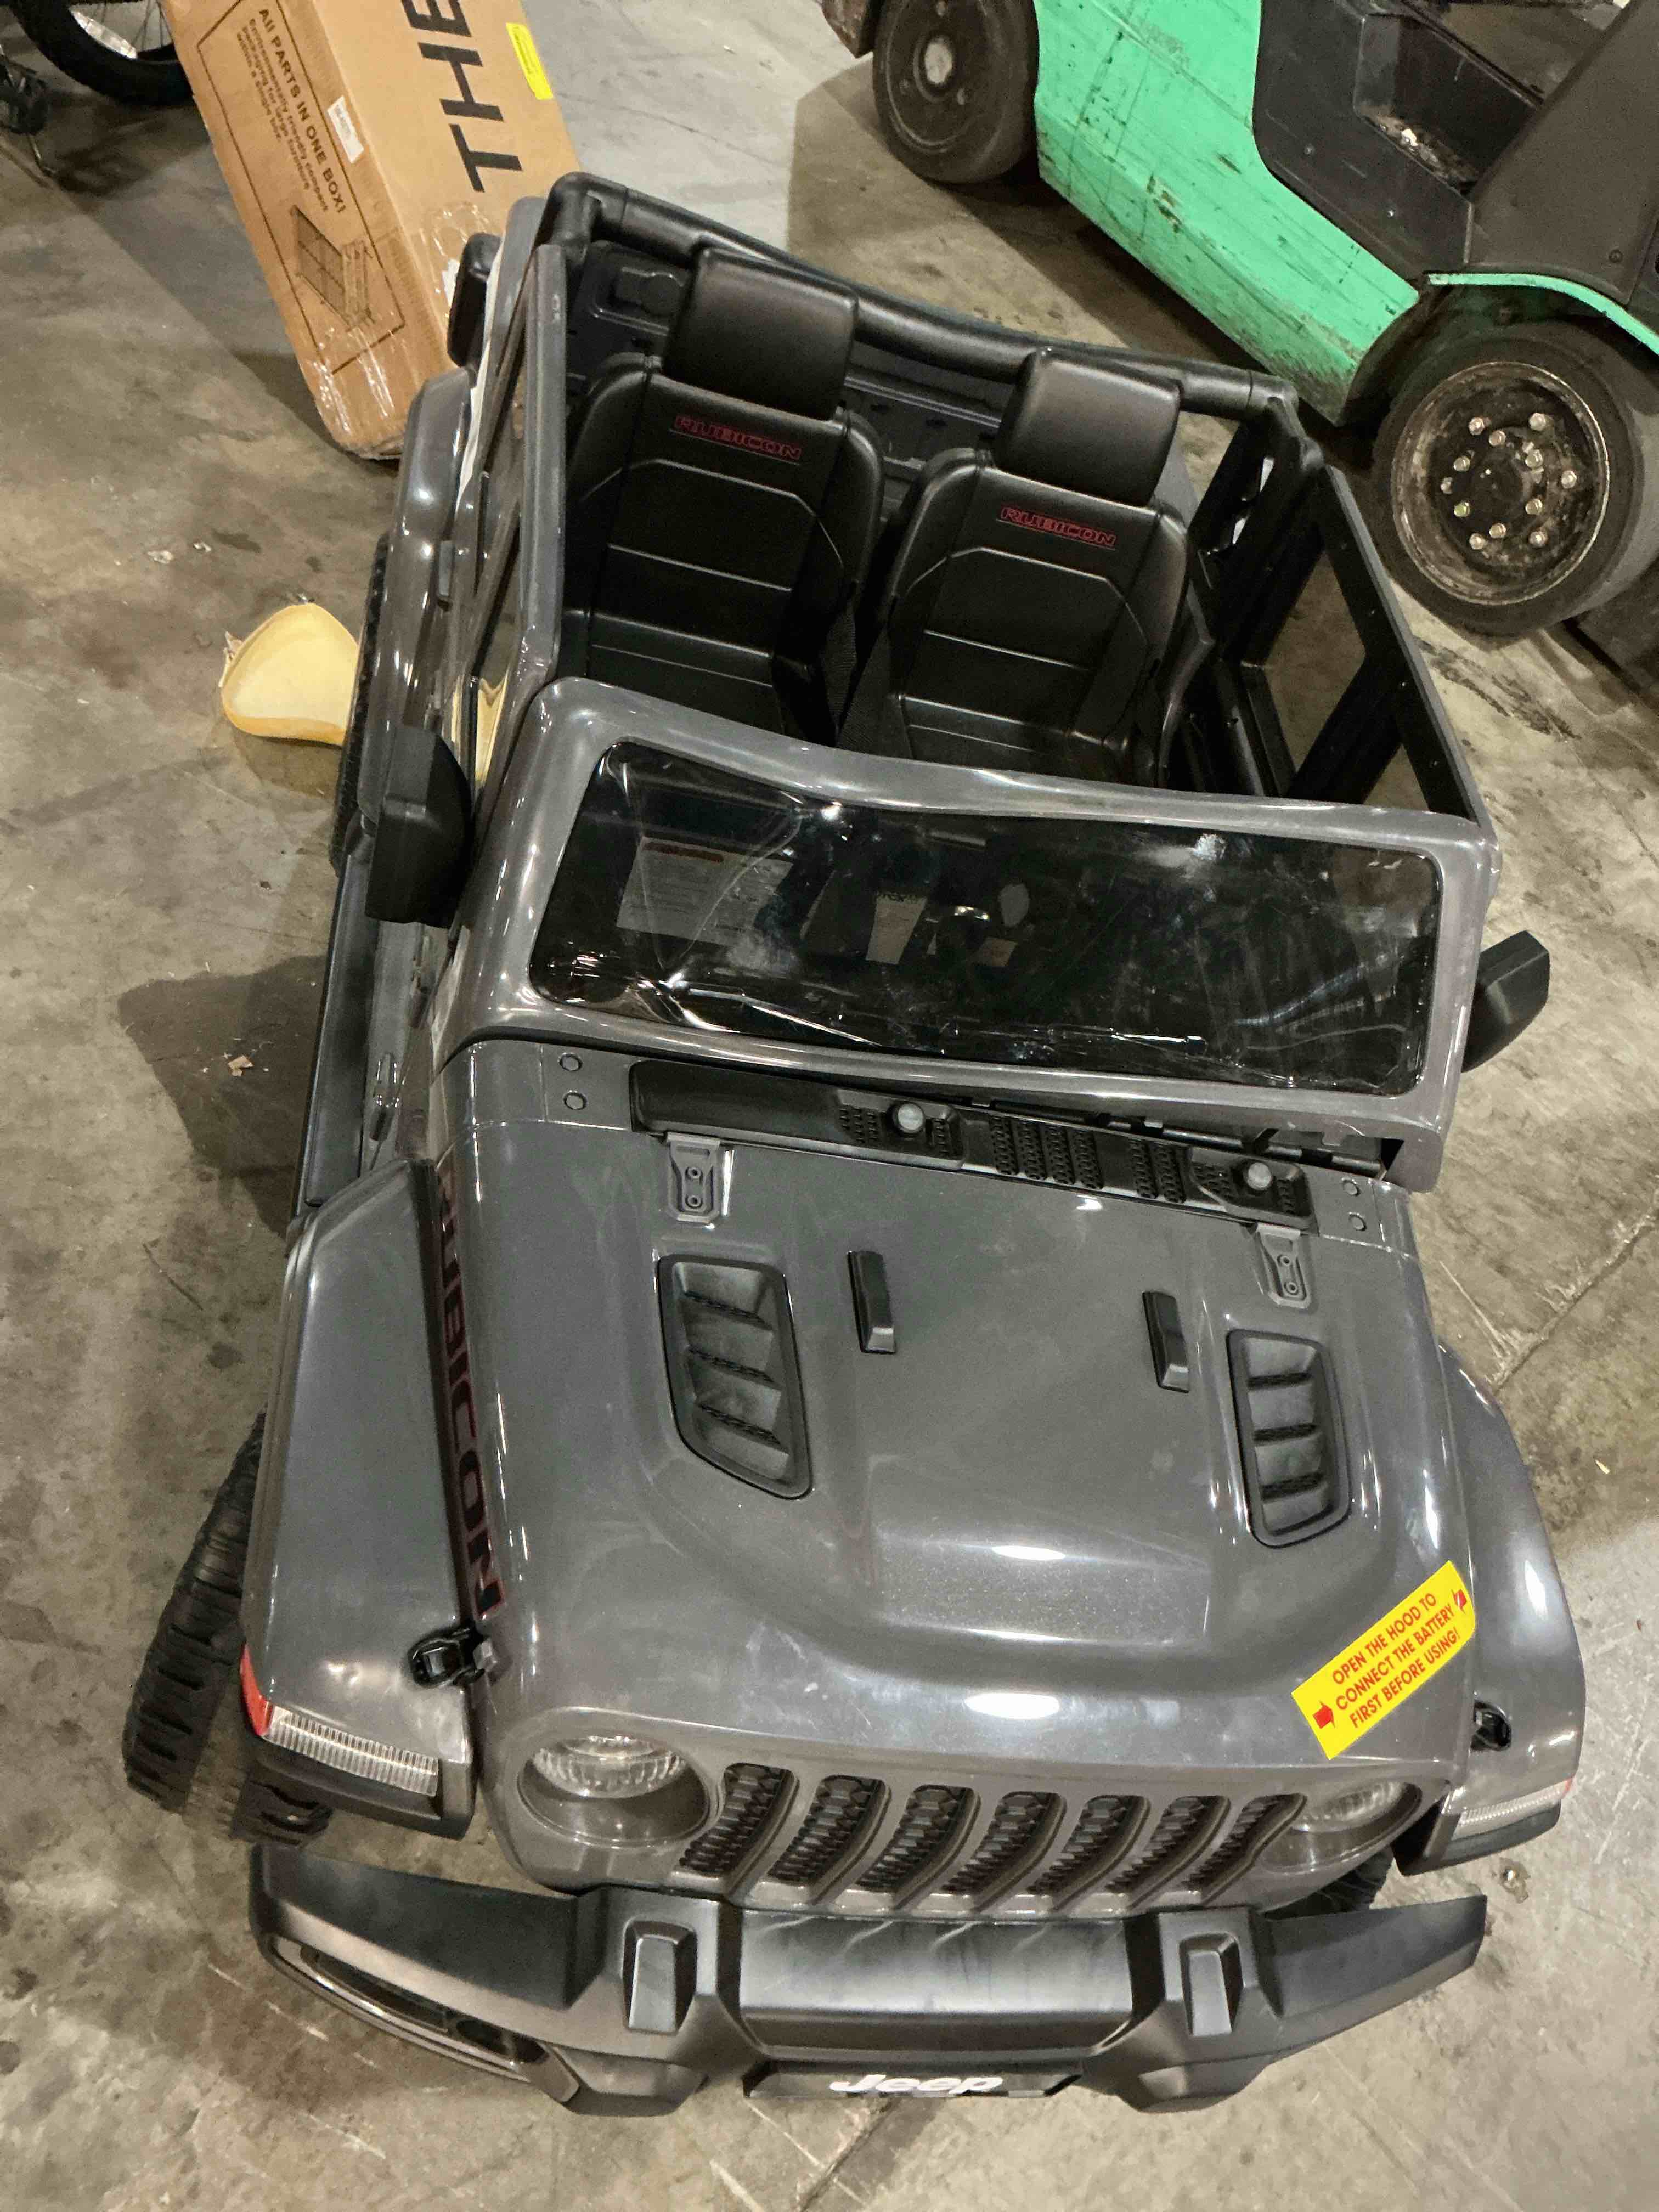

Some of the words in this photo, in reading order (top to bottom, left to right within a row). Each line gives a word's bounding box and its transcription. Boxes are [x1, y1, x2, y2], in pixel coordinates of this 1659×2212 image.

[271, 35, 300, 98] PARTS
[297, 101, 310, 121] IN
[307, 126, 327, 165] ONE
[323, 168, 346, 213] BOX!
[401, 0, 523, 193] THE
[675, 416, 802, 460] RUBICON
[1001, 507, 1116, 546] RUBICON
[1332, 1652, 1367, 1685] OPEN
[1364, 1634, 1387, 1657] THE
[1386, 1606, 1421, 1639] HOOD
[1419, 1593, 1436, 1611] TO
[1335, 1655, 1396, 1710] CONNECT
[1392, 1639, 1416, 1662] THE
[1413, 1603, 1455, 1646] BATTERY
[1349, 1694, 1383, 1728] FIRST
[1381, 1658, 1426, 1701] BEFORE
[1424, 1626, 1460, 1664] USING!
[829, 2074, 1003, 2094] Jeep
